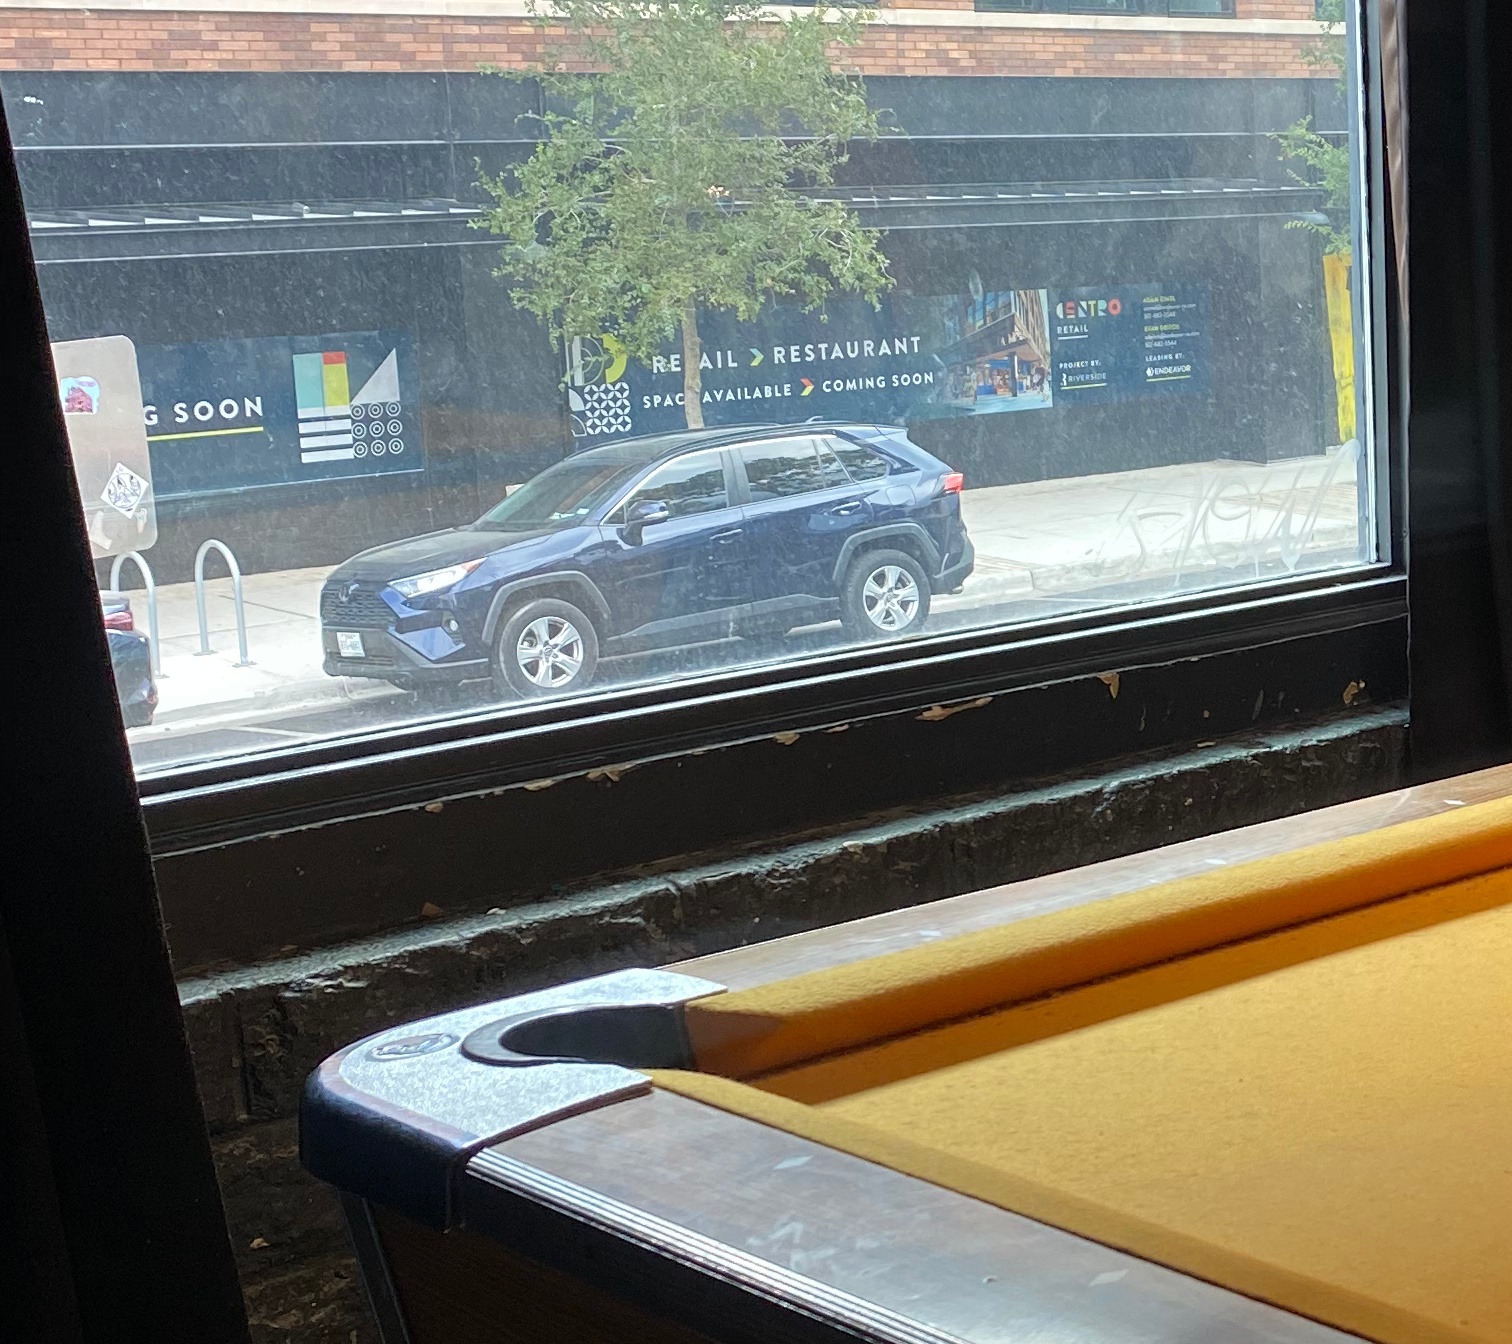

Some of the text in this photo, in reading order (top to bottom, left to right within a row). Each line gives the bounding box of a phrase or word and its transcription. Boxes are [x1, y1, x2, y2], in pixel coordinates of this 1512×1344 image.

[1056, 298, 1122, 319] CENTRO
[1057, 324, 1089, 335] RETAIL
[652, 336, 921, 374] REAIL RESTAURANT
[643, 371, 935, 409] SPAC AVAILABLE COMING SOON
[173, 396, 263, 423] SOON
